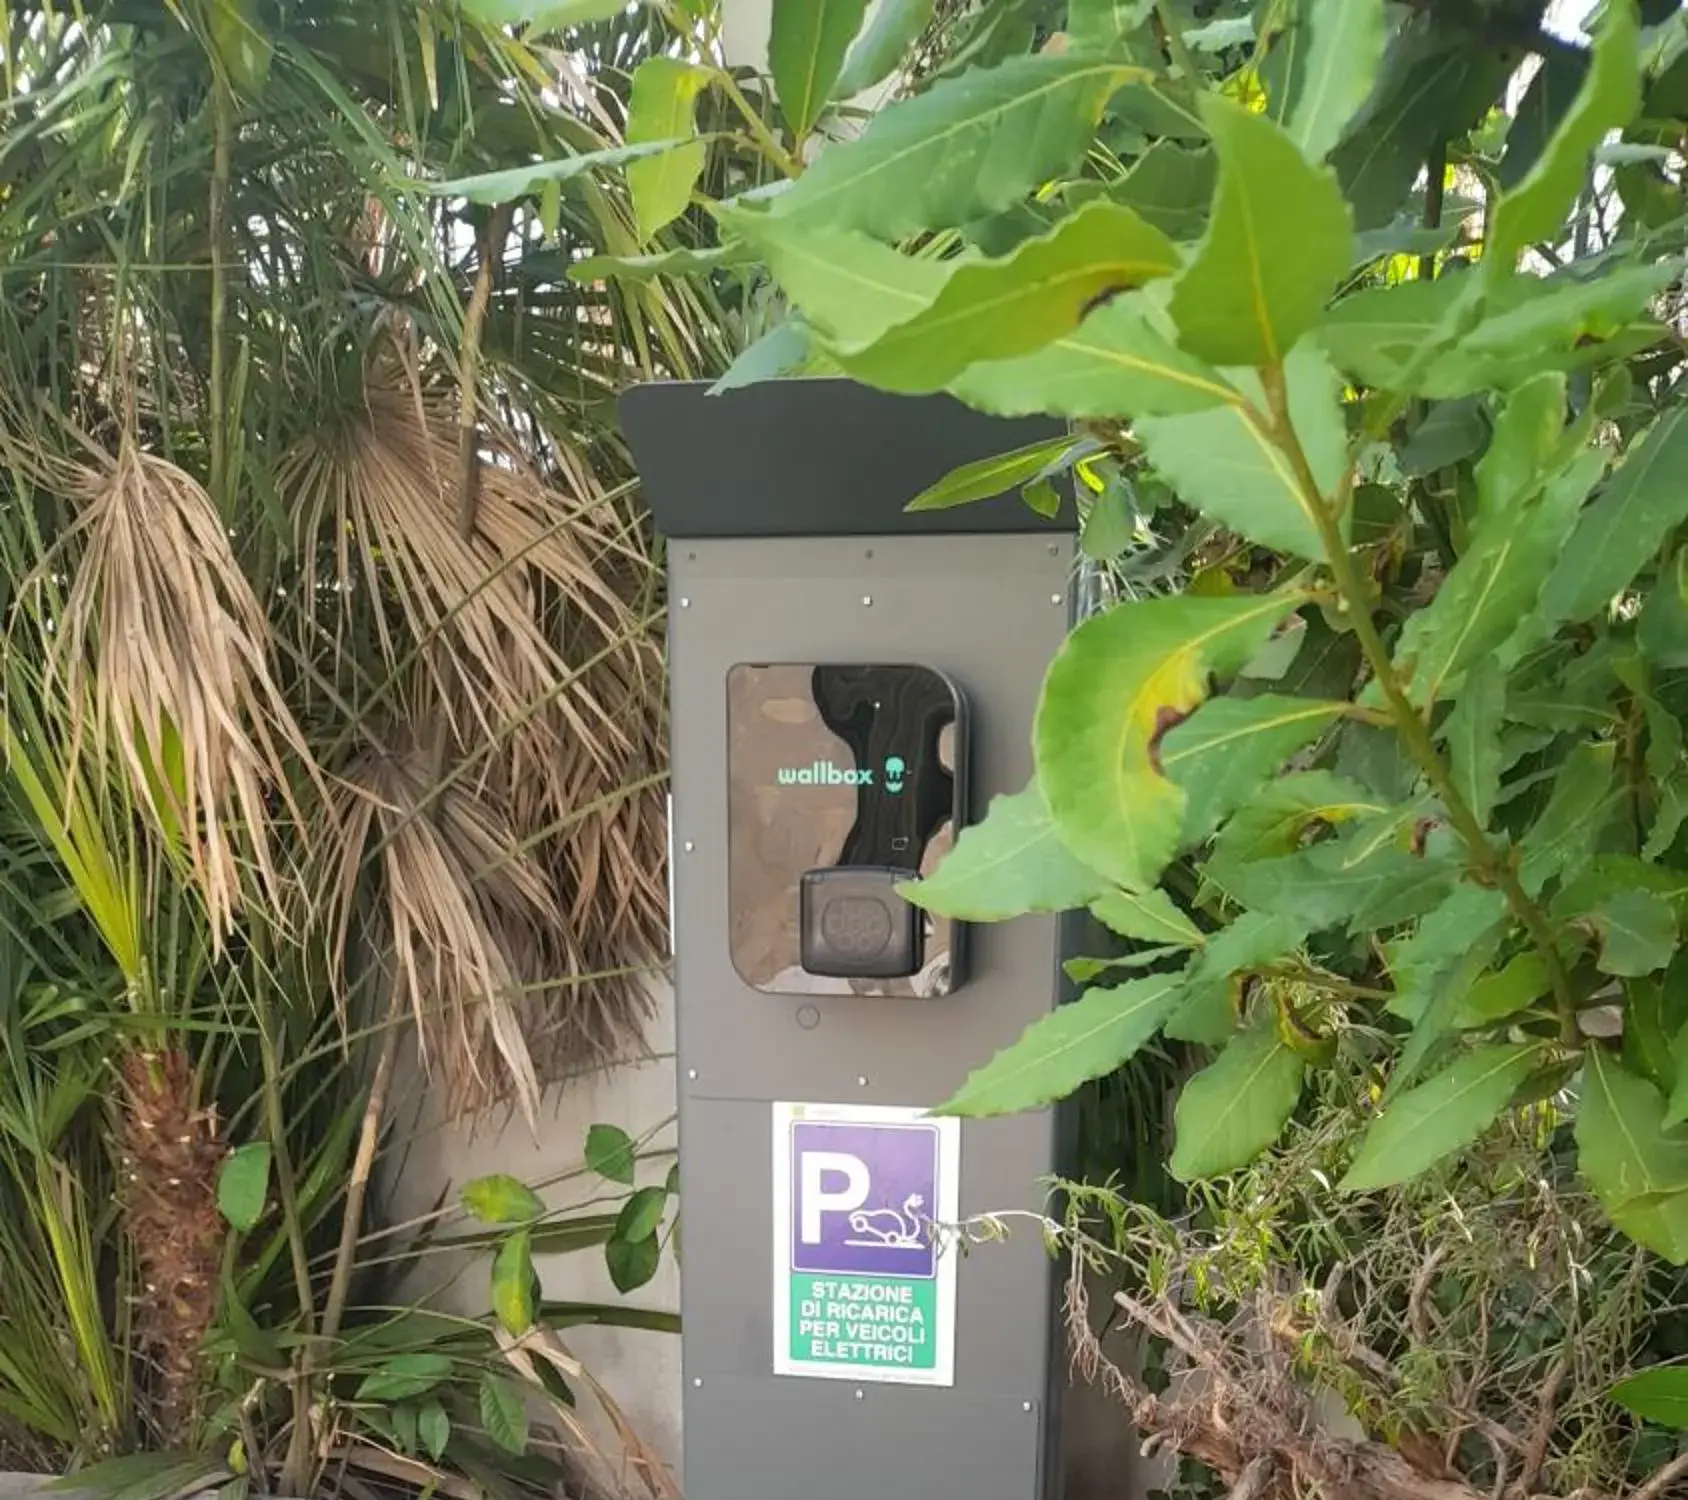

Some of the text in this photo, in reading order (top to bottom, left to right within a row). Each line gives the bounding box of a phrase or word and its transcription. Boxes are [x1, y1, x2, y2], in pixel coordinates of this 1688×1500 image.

[778, 761, 873, 785] wallbox
[801, 1151, 871, 1245] P
[811, 1281, 913, 1304] STAZIONE
[801, 1302, 924, 1324] DI RICARICA
[800, 1320, 925, 1344] PER VEICOLI
[811, 1340, 913, 1363] ELETTRICI
